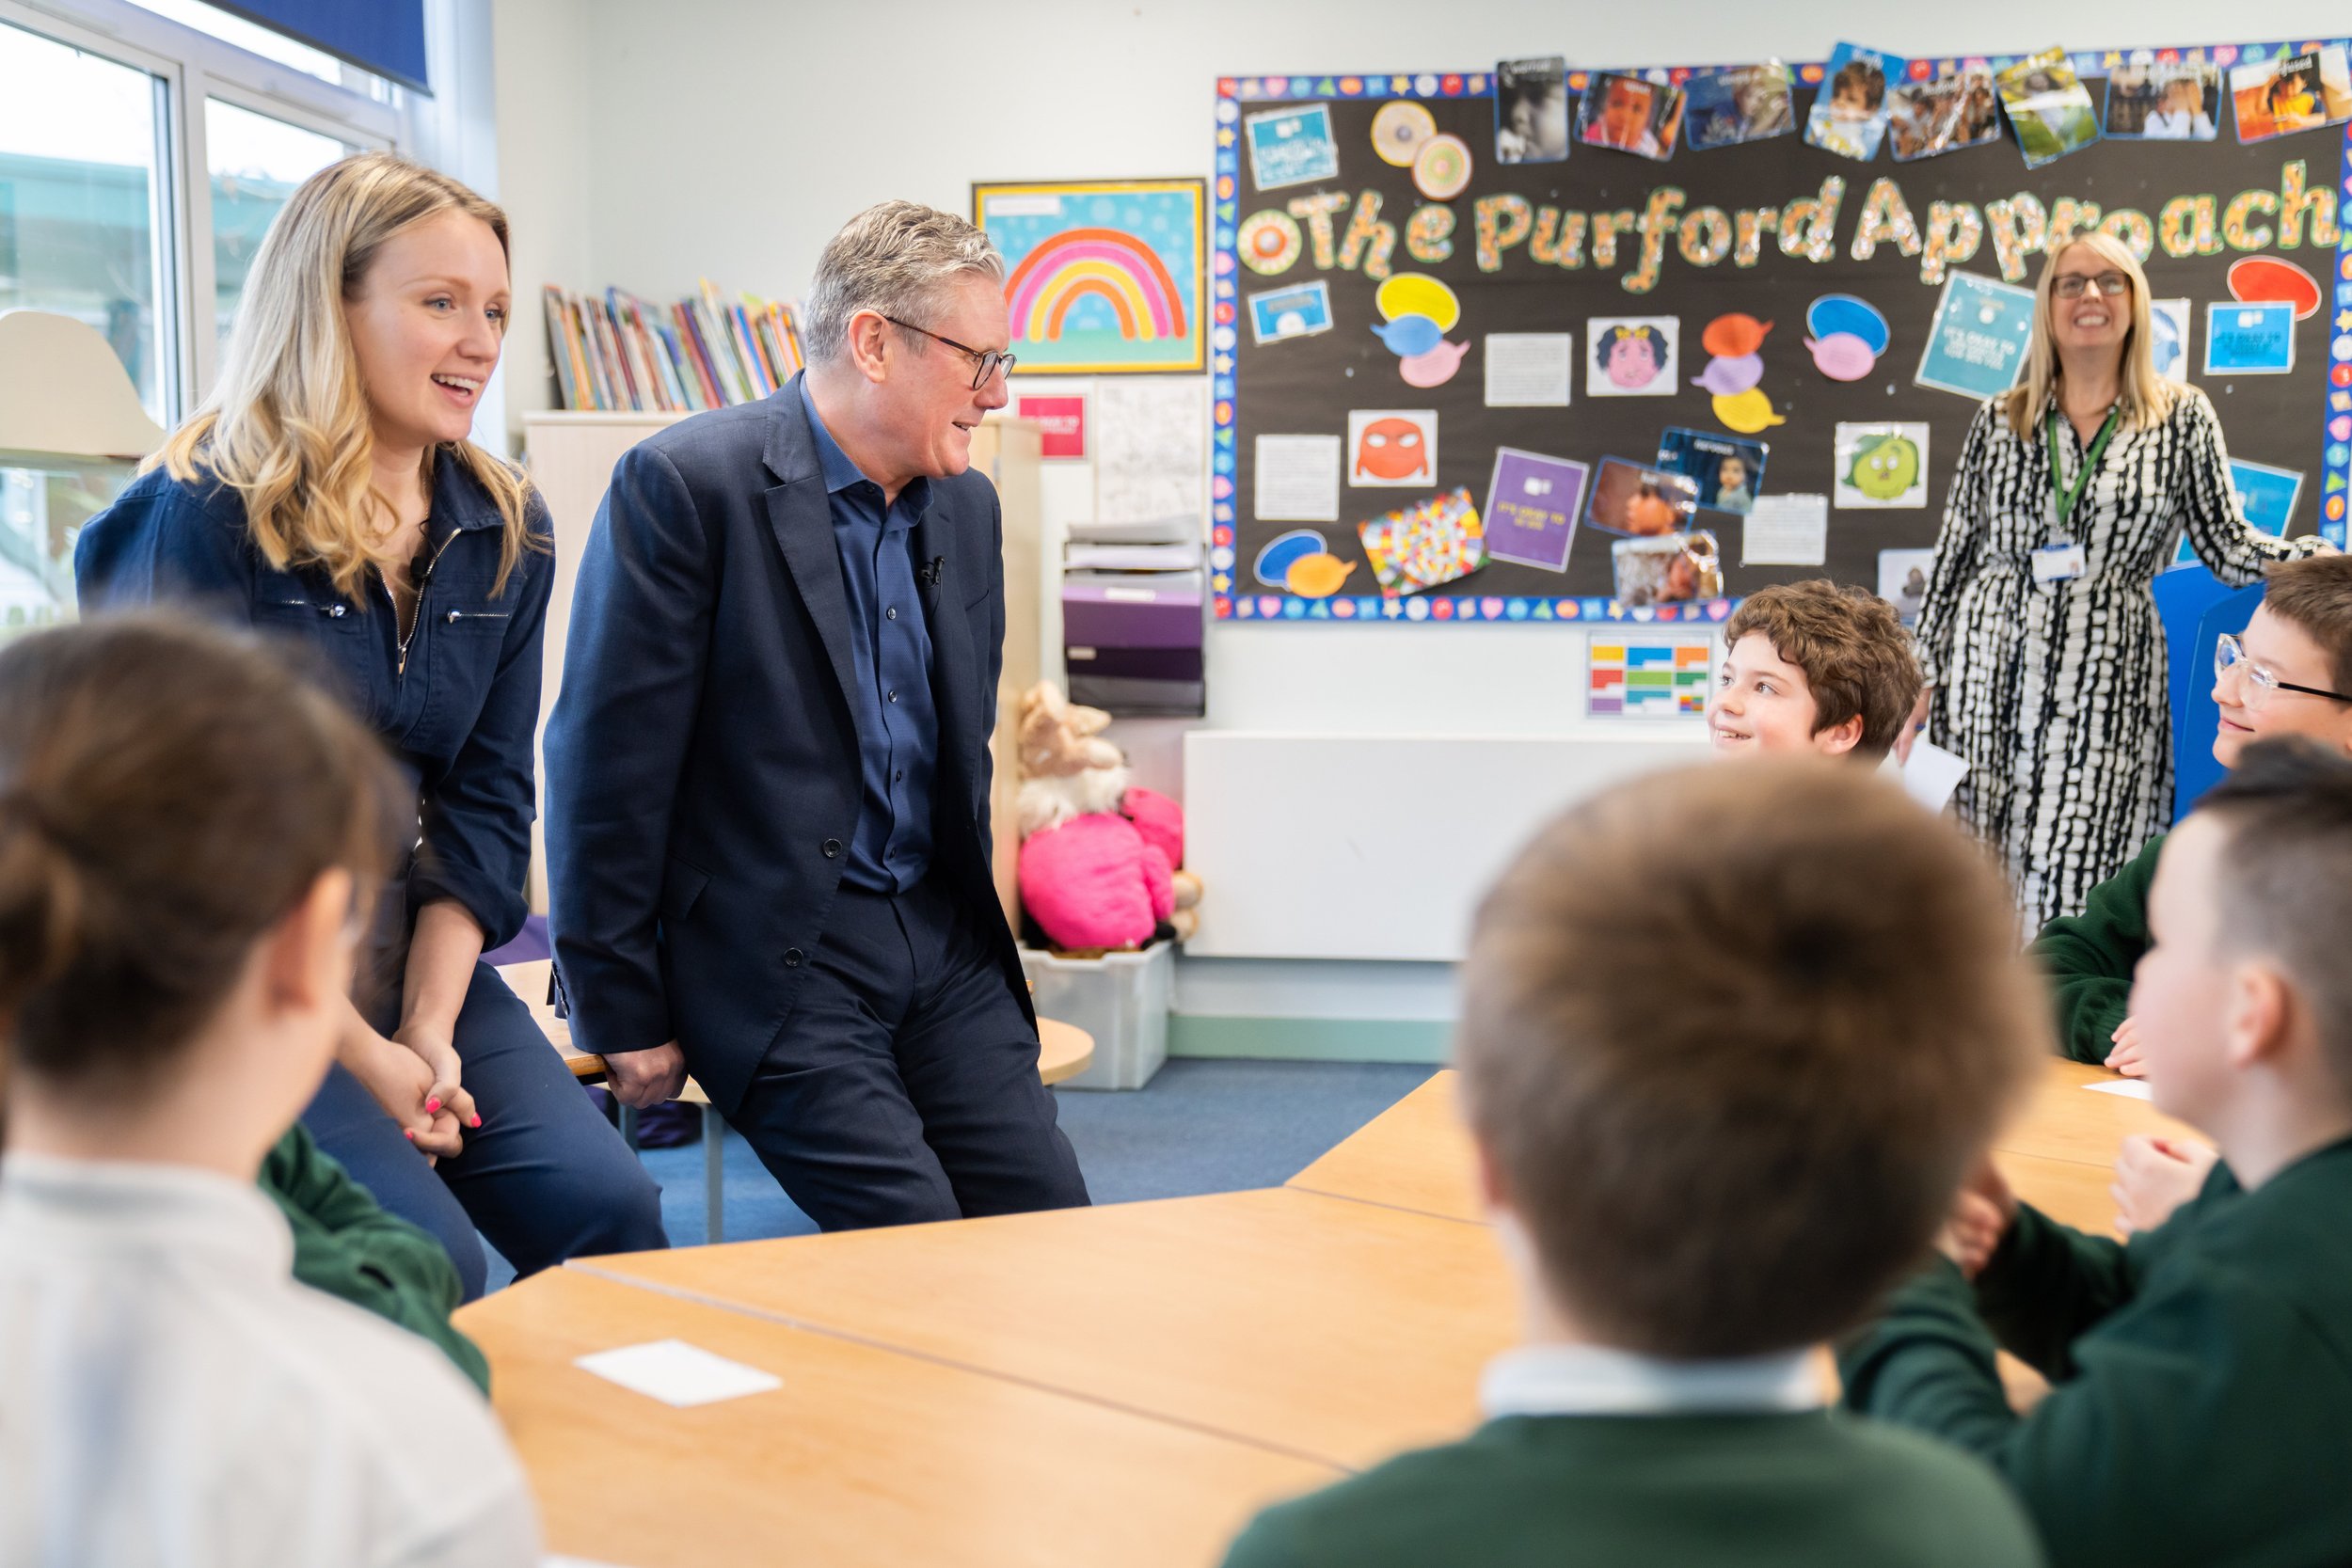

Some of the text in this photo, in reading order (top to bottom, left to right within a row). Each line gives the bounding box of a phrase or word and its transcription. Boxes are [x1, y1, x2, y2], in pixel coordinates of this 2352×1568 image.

[1287, 159, 2342, 294] The Purford Approach
